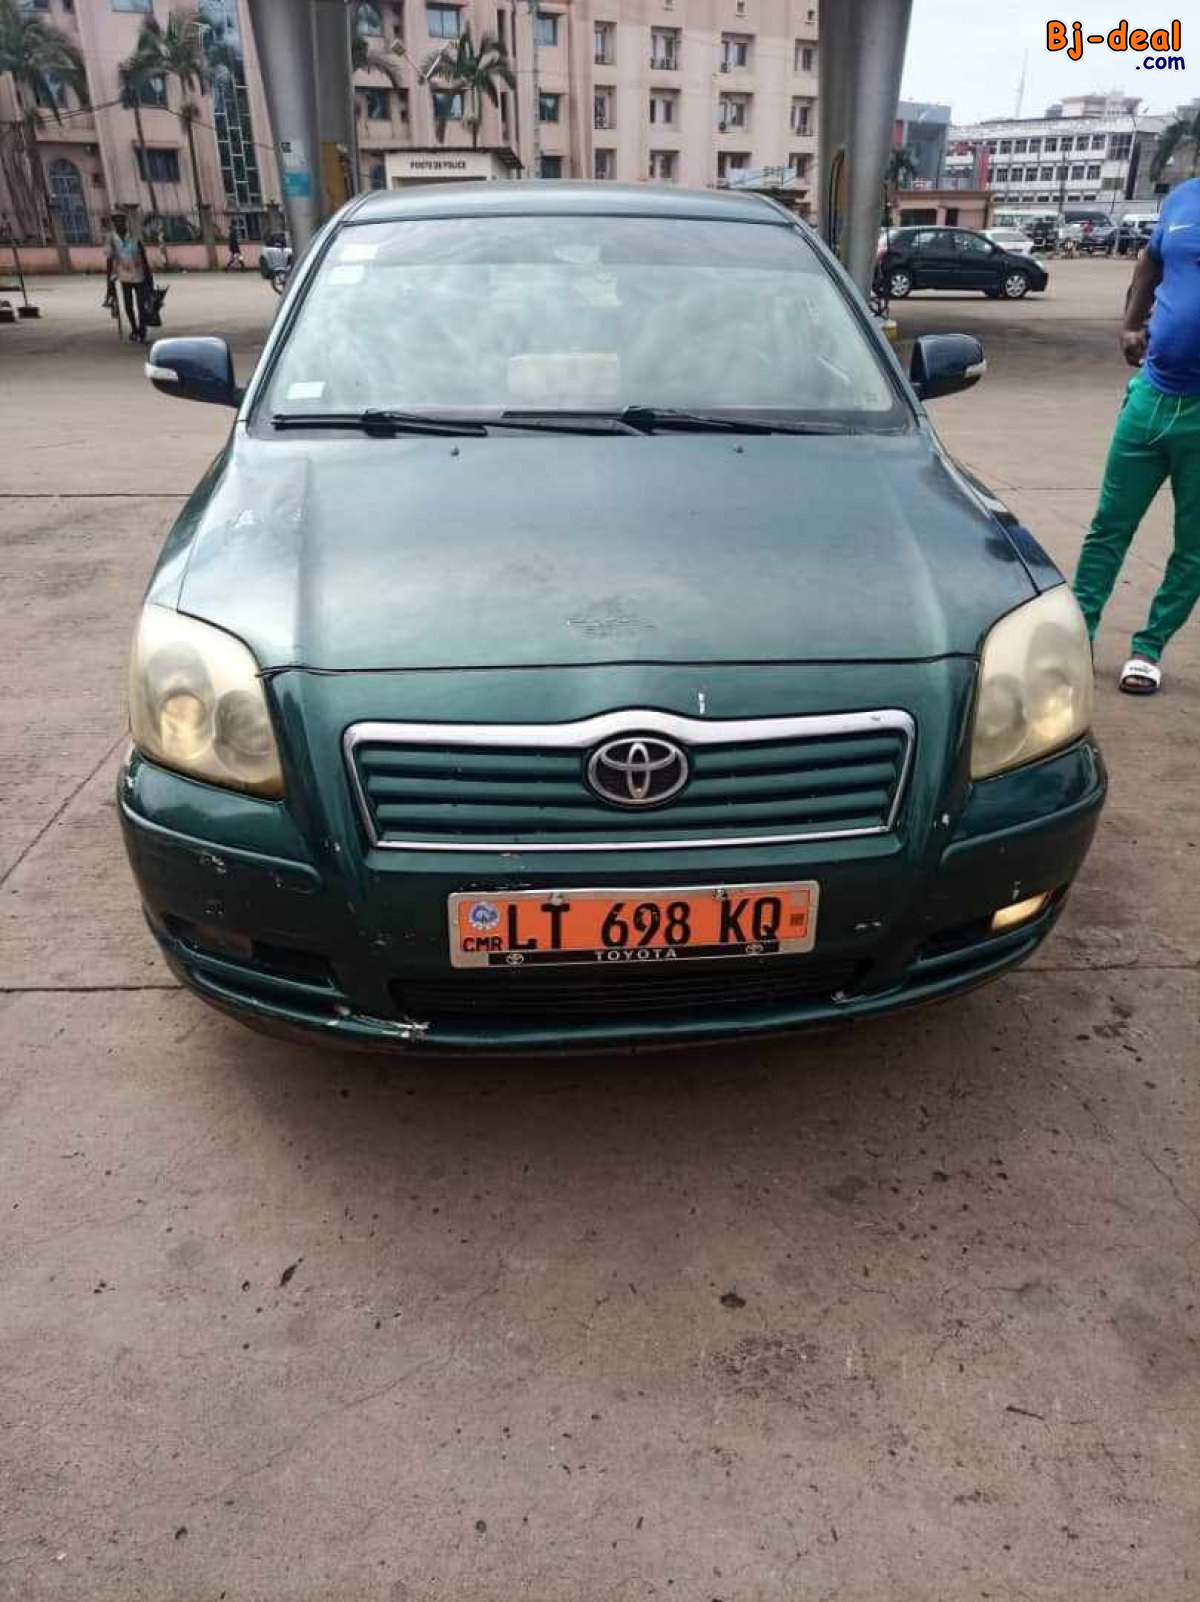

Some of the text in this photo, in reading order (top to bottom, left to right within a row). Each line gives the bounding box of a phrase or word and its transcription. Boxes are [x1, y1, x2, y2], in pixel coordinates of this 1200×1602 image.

[507, 896, 782, 949] LT 698 KQ
[463, 935, 503, 952] CMR
[595, 948, 677, 960] TOYOTA
